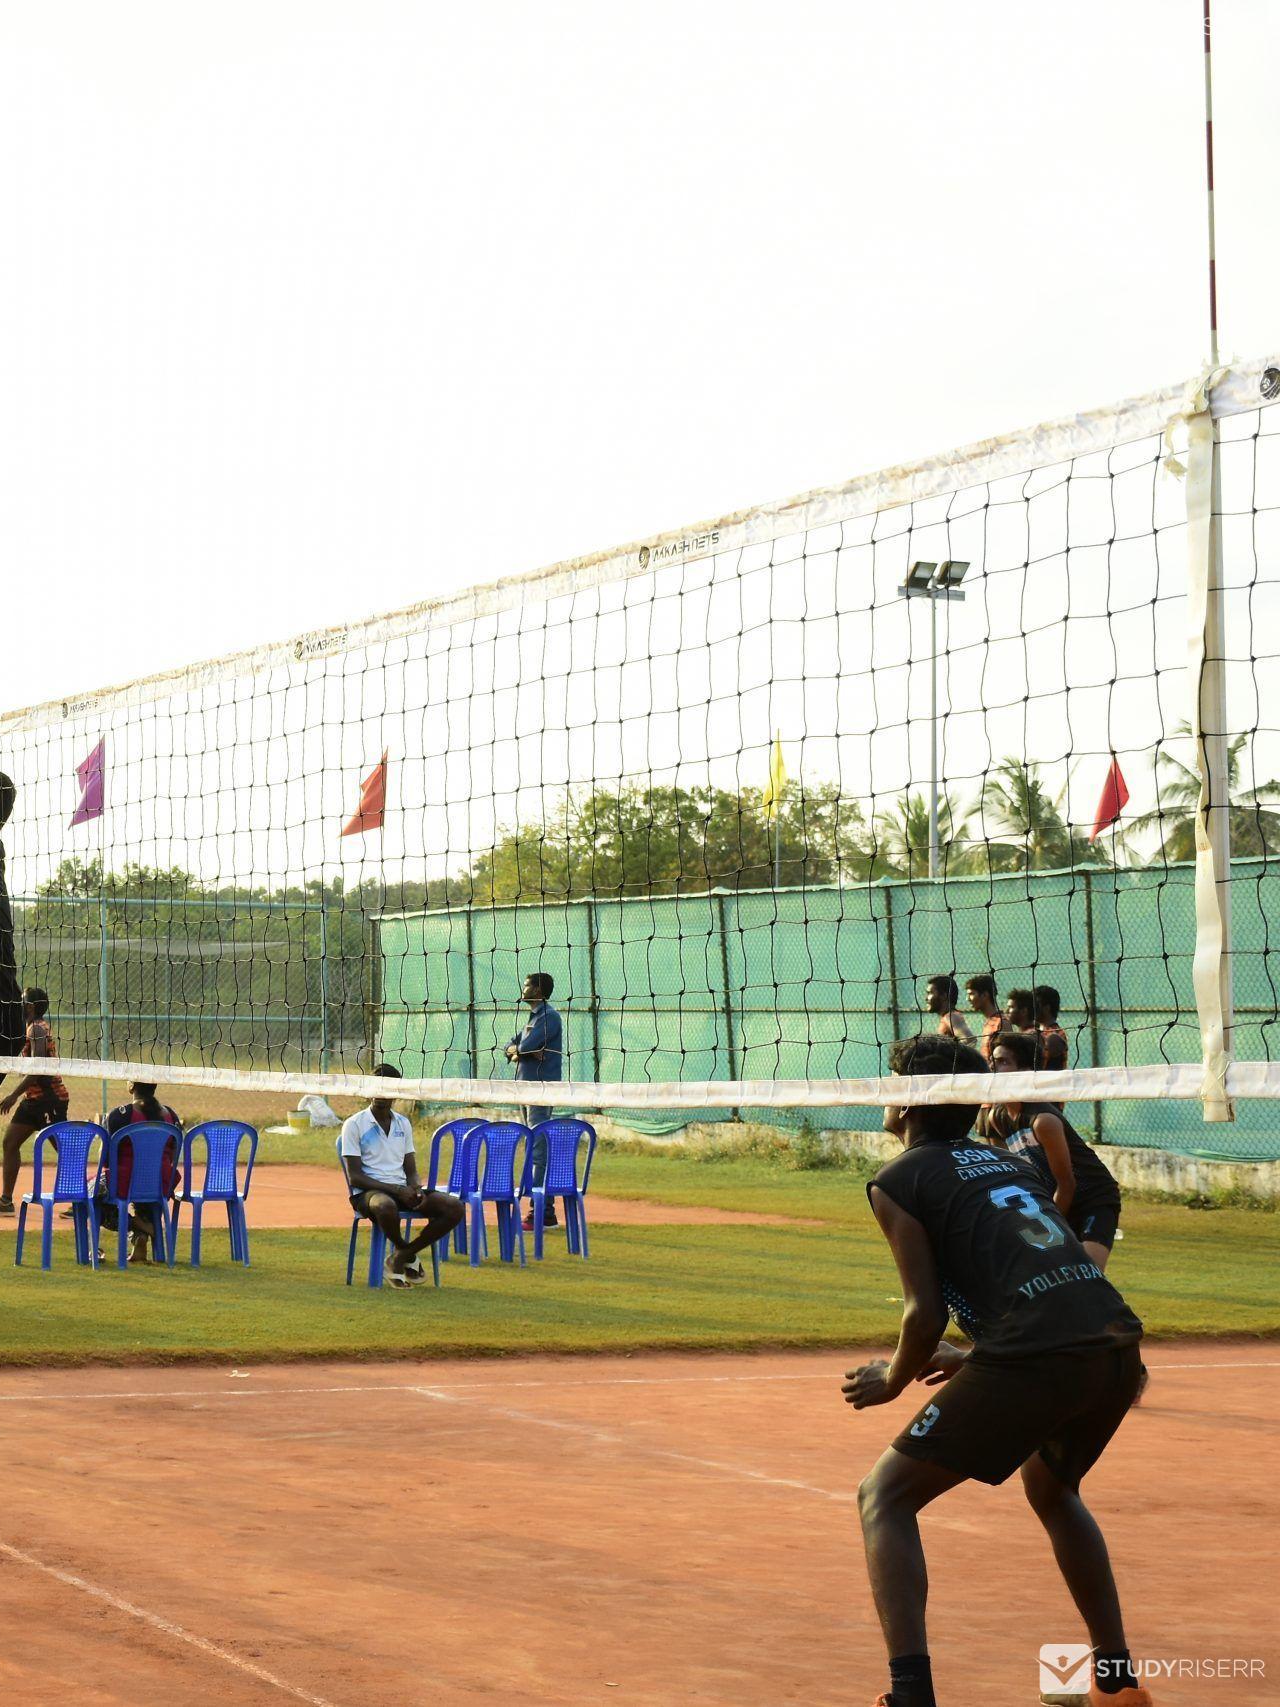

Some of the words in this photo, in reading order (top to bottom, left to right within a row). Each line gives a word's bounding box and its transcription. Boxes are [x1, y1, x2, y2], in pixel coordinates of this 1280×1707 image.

[951, 1150, 999, 1165] SSN
[958, 1164, 1019, 1181] CHENNAI
[988, 1185, 1065, 1251] 3
[910, 1403, 940, 1437] 3
